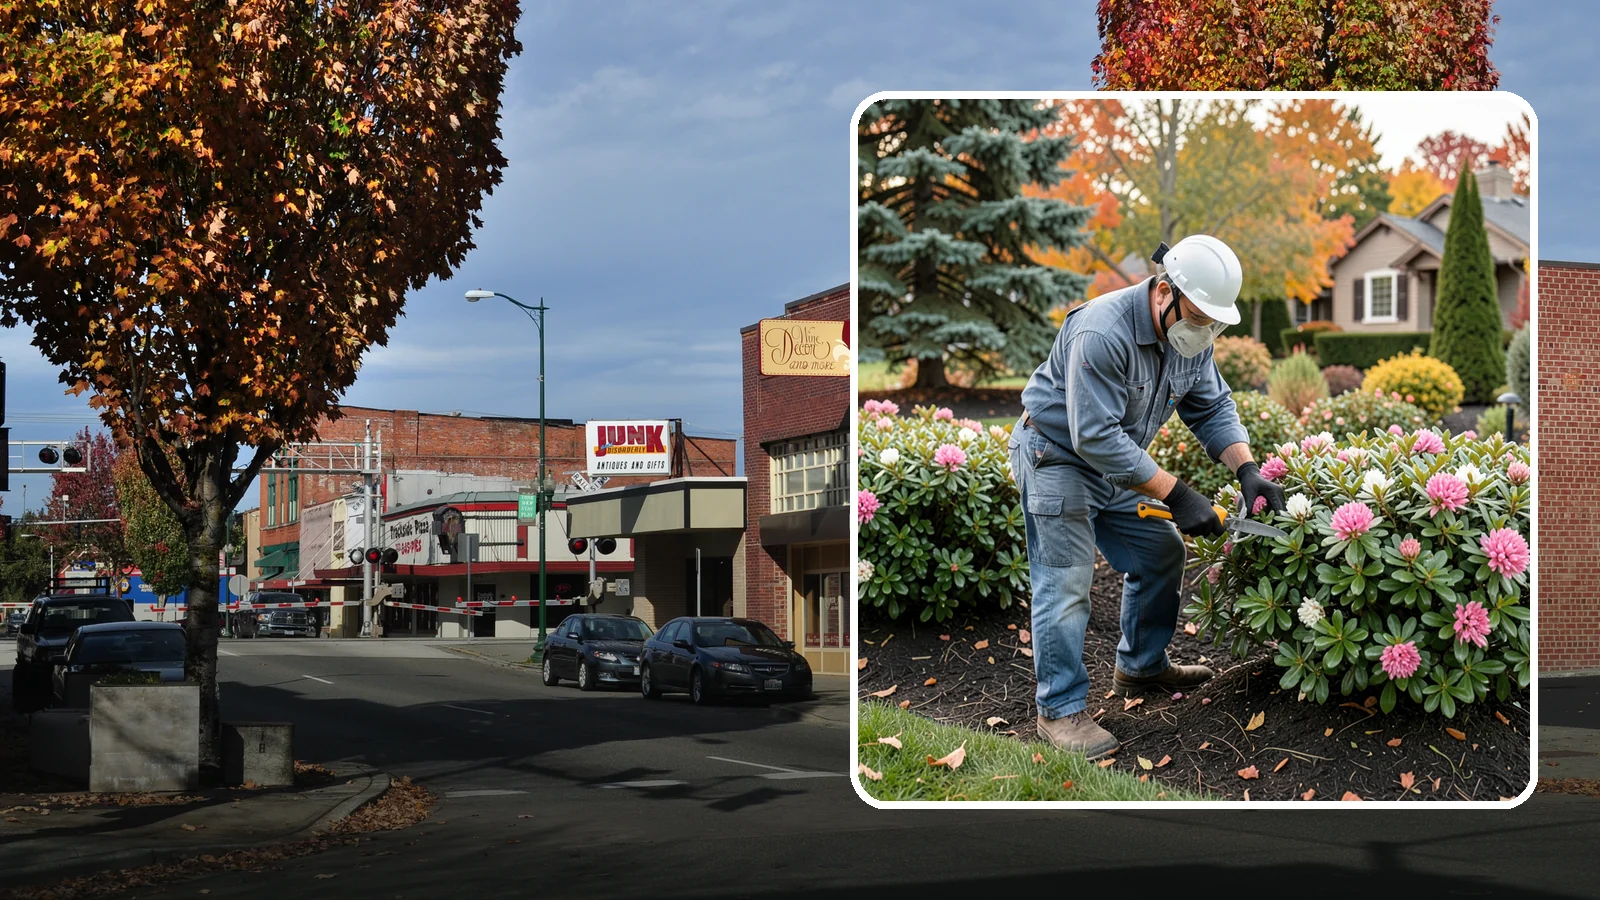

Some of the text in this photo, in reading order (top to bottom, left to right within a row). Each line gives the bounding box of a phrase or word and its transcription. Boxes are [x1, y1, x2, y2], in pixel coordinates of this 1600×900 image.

[765, 327, 831, 365] Decor
[595, 425, 665, 457] JUNK
[607, 446, 645, 454] DISORDERLY
[597, 461, 665, 470] ANTIQUES AND GIFTS
[573, 473, 587, 491] RAIL
[352, 498, 365, 511] CRO
[414, 519, 429, 535] Pizza
